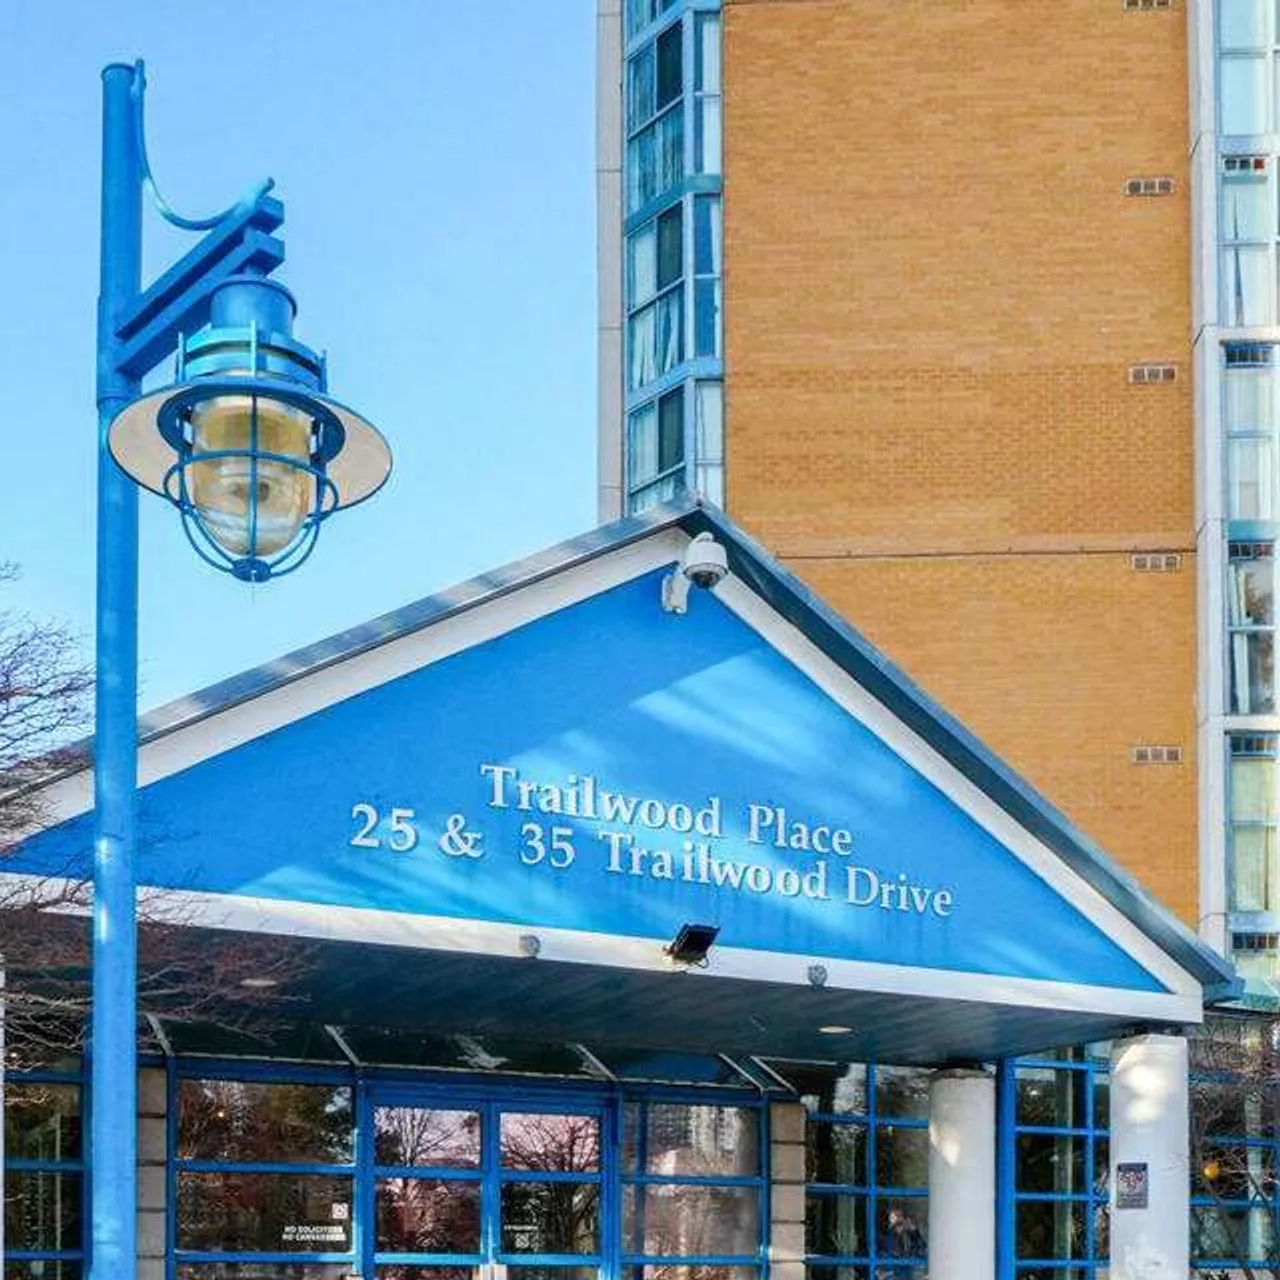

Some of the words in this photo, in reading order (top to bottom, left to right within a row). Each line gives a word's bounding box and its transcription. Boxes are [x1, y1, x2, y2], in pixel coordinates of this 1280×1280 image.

[350, 802, 419, 852] 25
[437, 813, 484, 858] &
[519, 822, 575, 868] 35
[598, 831, 829, 901] Trailwood
[846, 864, 955, 917] Drive
[480, 763, 722, 838] Trailwood
[748, 803, 853, 856] Place
